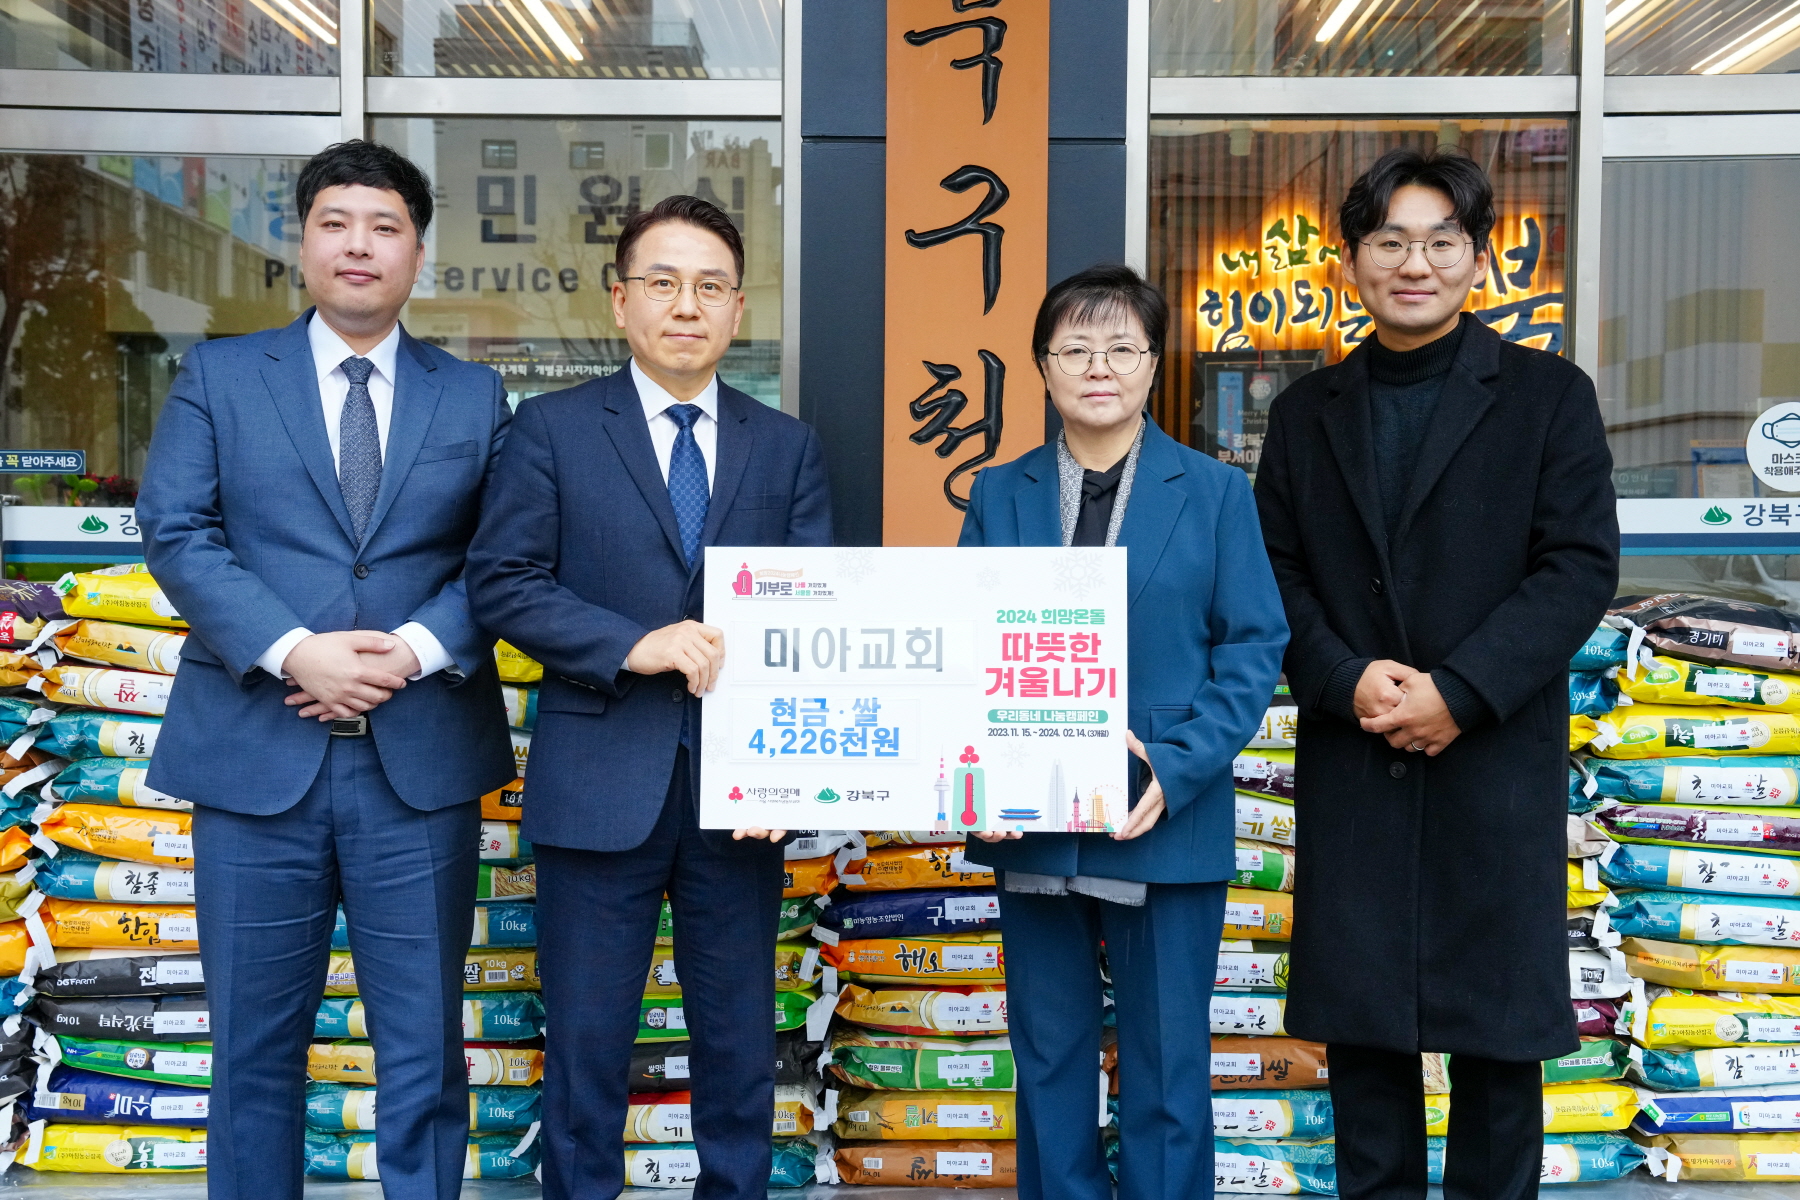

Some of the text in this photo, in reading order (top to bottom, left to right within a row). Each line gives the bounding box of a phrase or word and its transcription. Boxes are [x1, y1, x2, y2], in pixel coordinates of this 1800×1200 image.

[1221, 252, 1259, 277] 내
[416, 263, 579, 293] Service
[6, 455, 78, 468] 꼭 닫아주세요
[1217, 450, 1261, 463] 부서이
[755, 581, 793, 596] 기부로
[996, 609, 1106, 625] 2024 희망온돌
[1689, 630, 1724, 647] 경기미
[764, 627, 943, 673] 미아교회
[1002, 632, 1102, 663] 따뜻한
[985, 667, 1117, 698] 겨울나기
[769, 697, 881, 727] 현금 쌀
[996, 710, 1099, 722] 우리동네 나눔캠페인
[748, 726, 900, 757] 4,226천원
[746, 787, 801, 800] 사랑의열매
[846, 790, 890, 802] 강북구
[1223, 909, 1240, 918] 아교회
[499, 920, 527, 933] 10kg
[56, 1014, 80, 1025] 10kg
[493, 1014, 521, 1026] 10kg
[488, 1107, 515, 1119] 10kg
[1212, 1110, 1236, 1119] 미아교회
